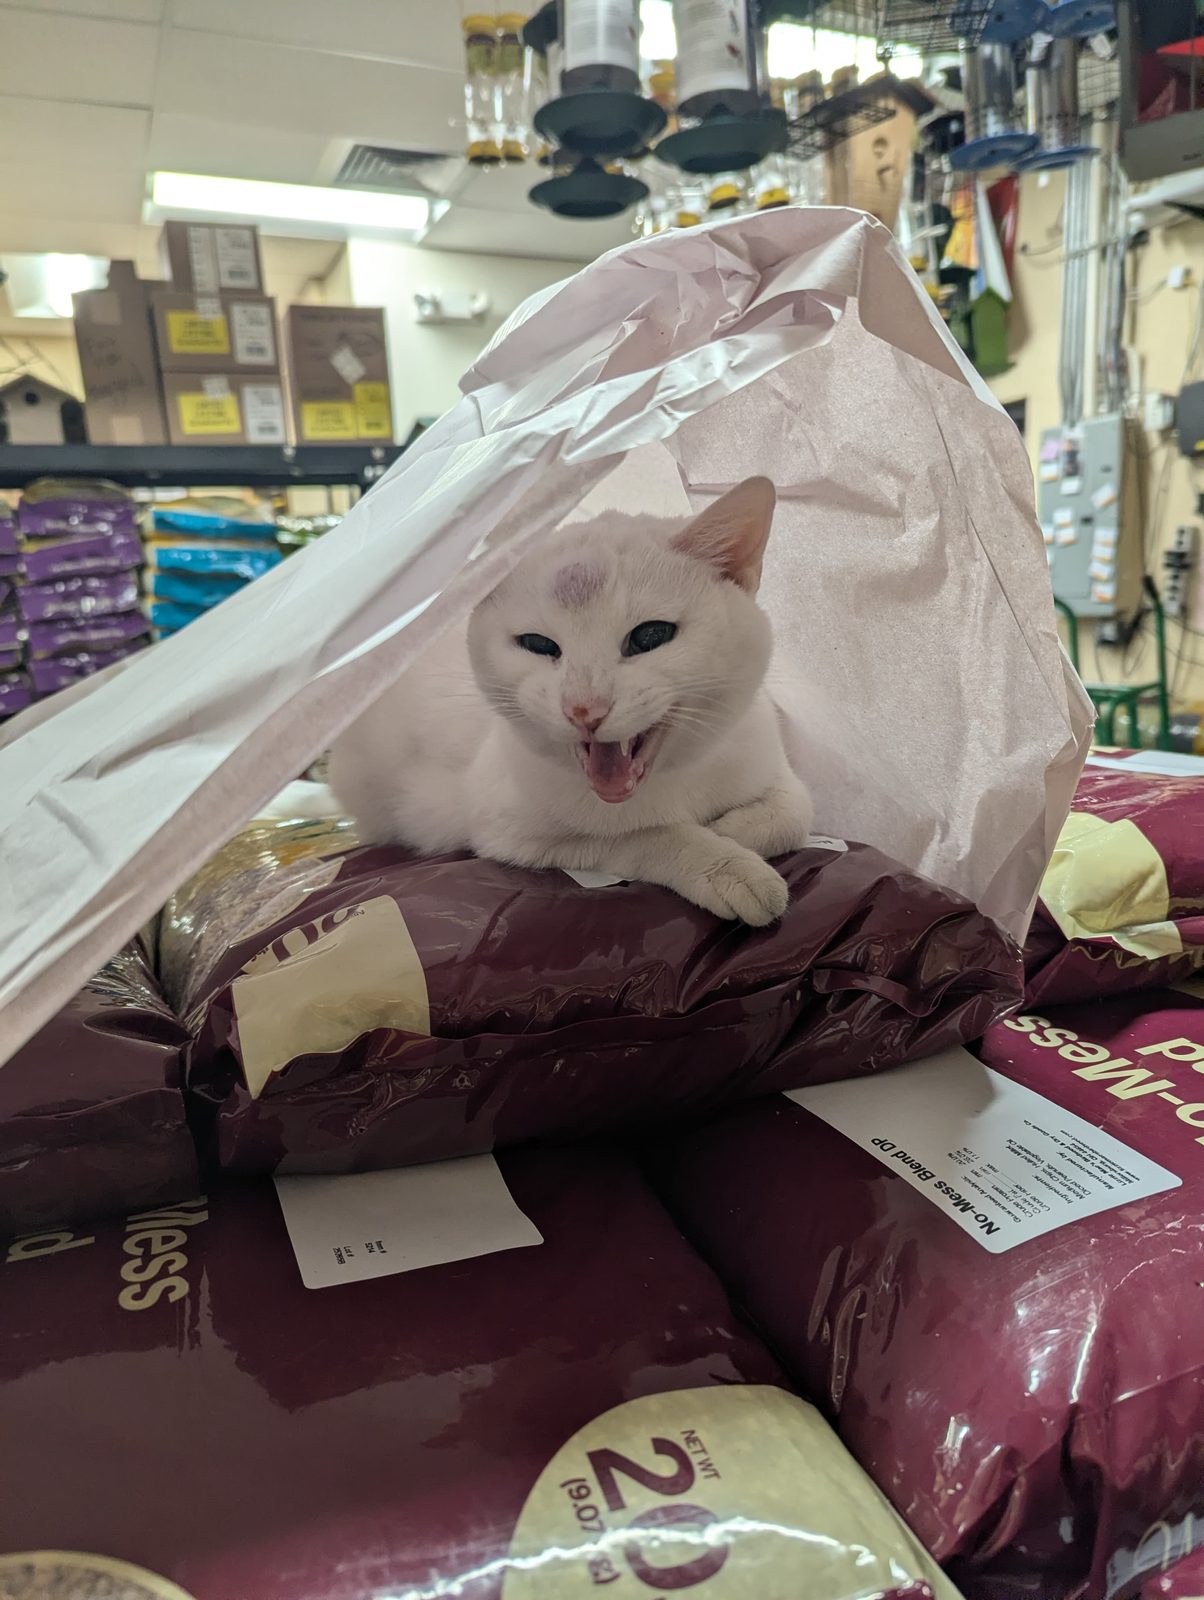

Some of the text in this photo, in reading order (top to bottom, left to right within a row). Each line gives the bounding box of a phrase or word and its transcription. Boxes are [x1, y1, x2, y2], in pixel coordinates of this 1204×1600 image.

[1003, 1015, 1204, 1148] o-Mess
[871, 1138, 1000, 1235] No-Mess Blend DP
[1065, 1158, 1114, 1189] Manufactured
[1070, 1181, 1091, 1195] Diced
[1059, 1181, 1085, 1199] Medium
[985, 1195, 1021, 1223] Guaranteed
[1013, 1202, 1033, 1217] Crude
[680, 1429, 721, 1481] NET WT
[586, 1437, 729, 1590] 20
